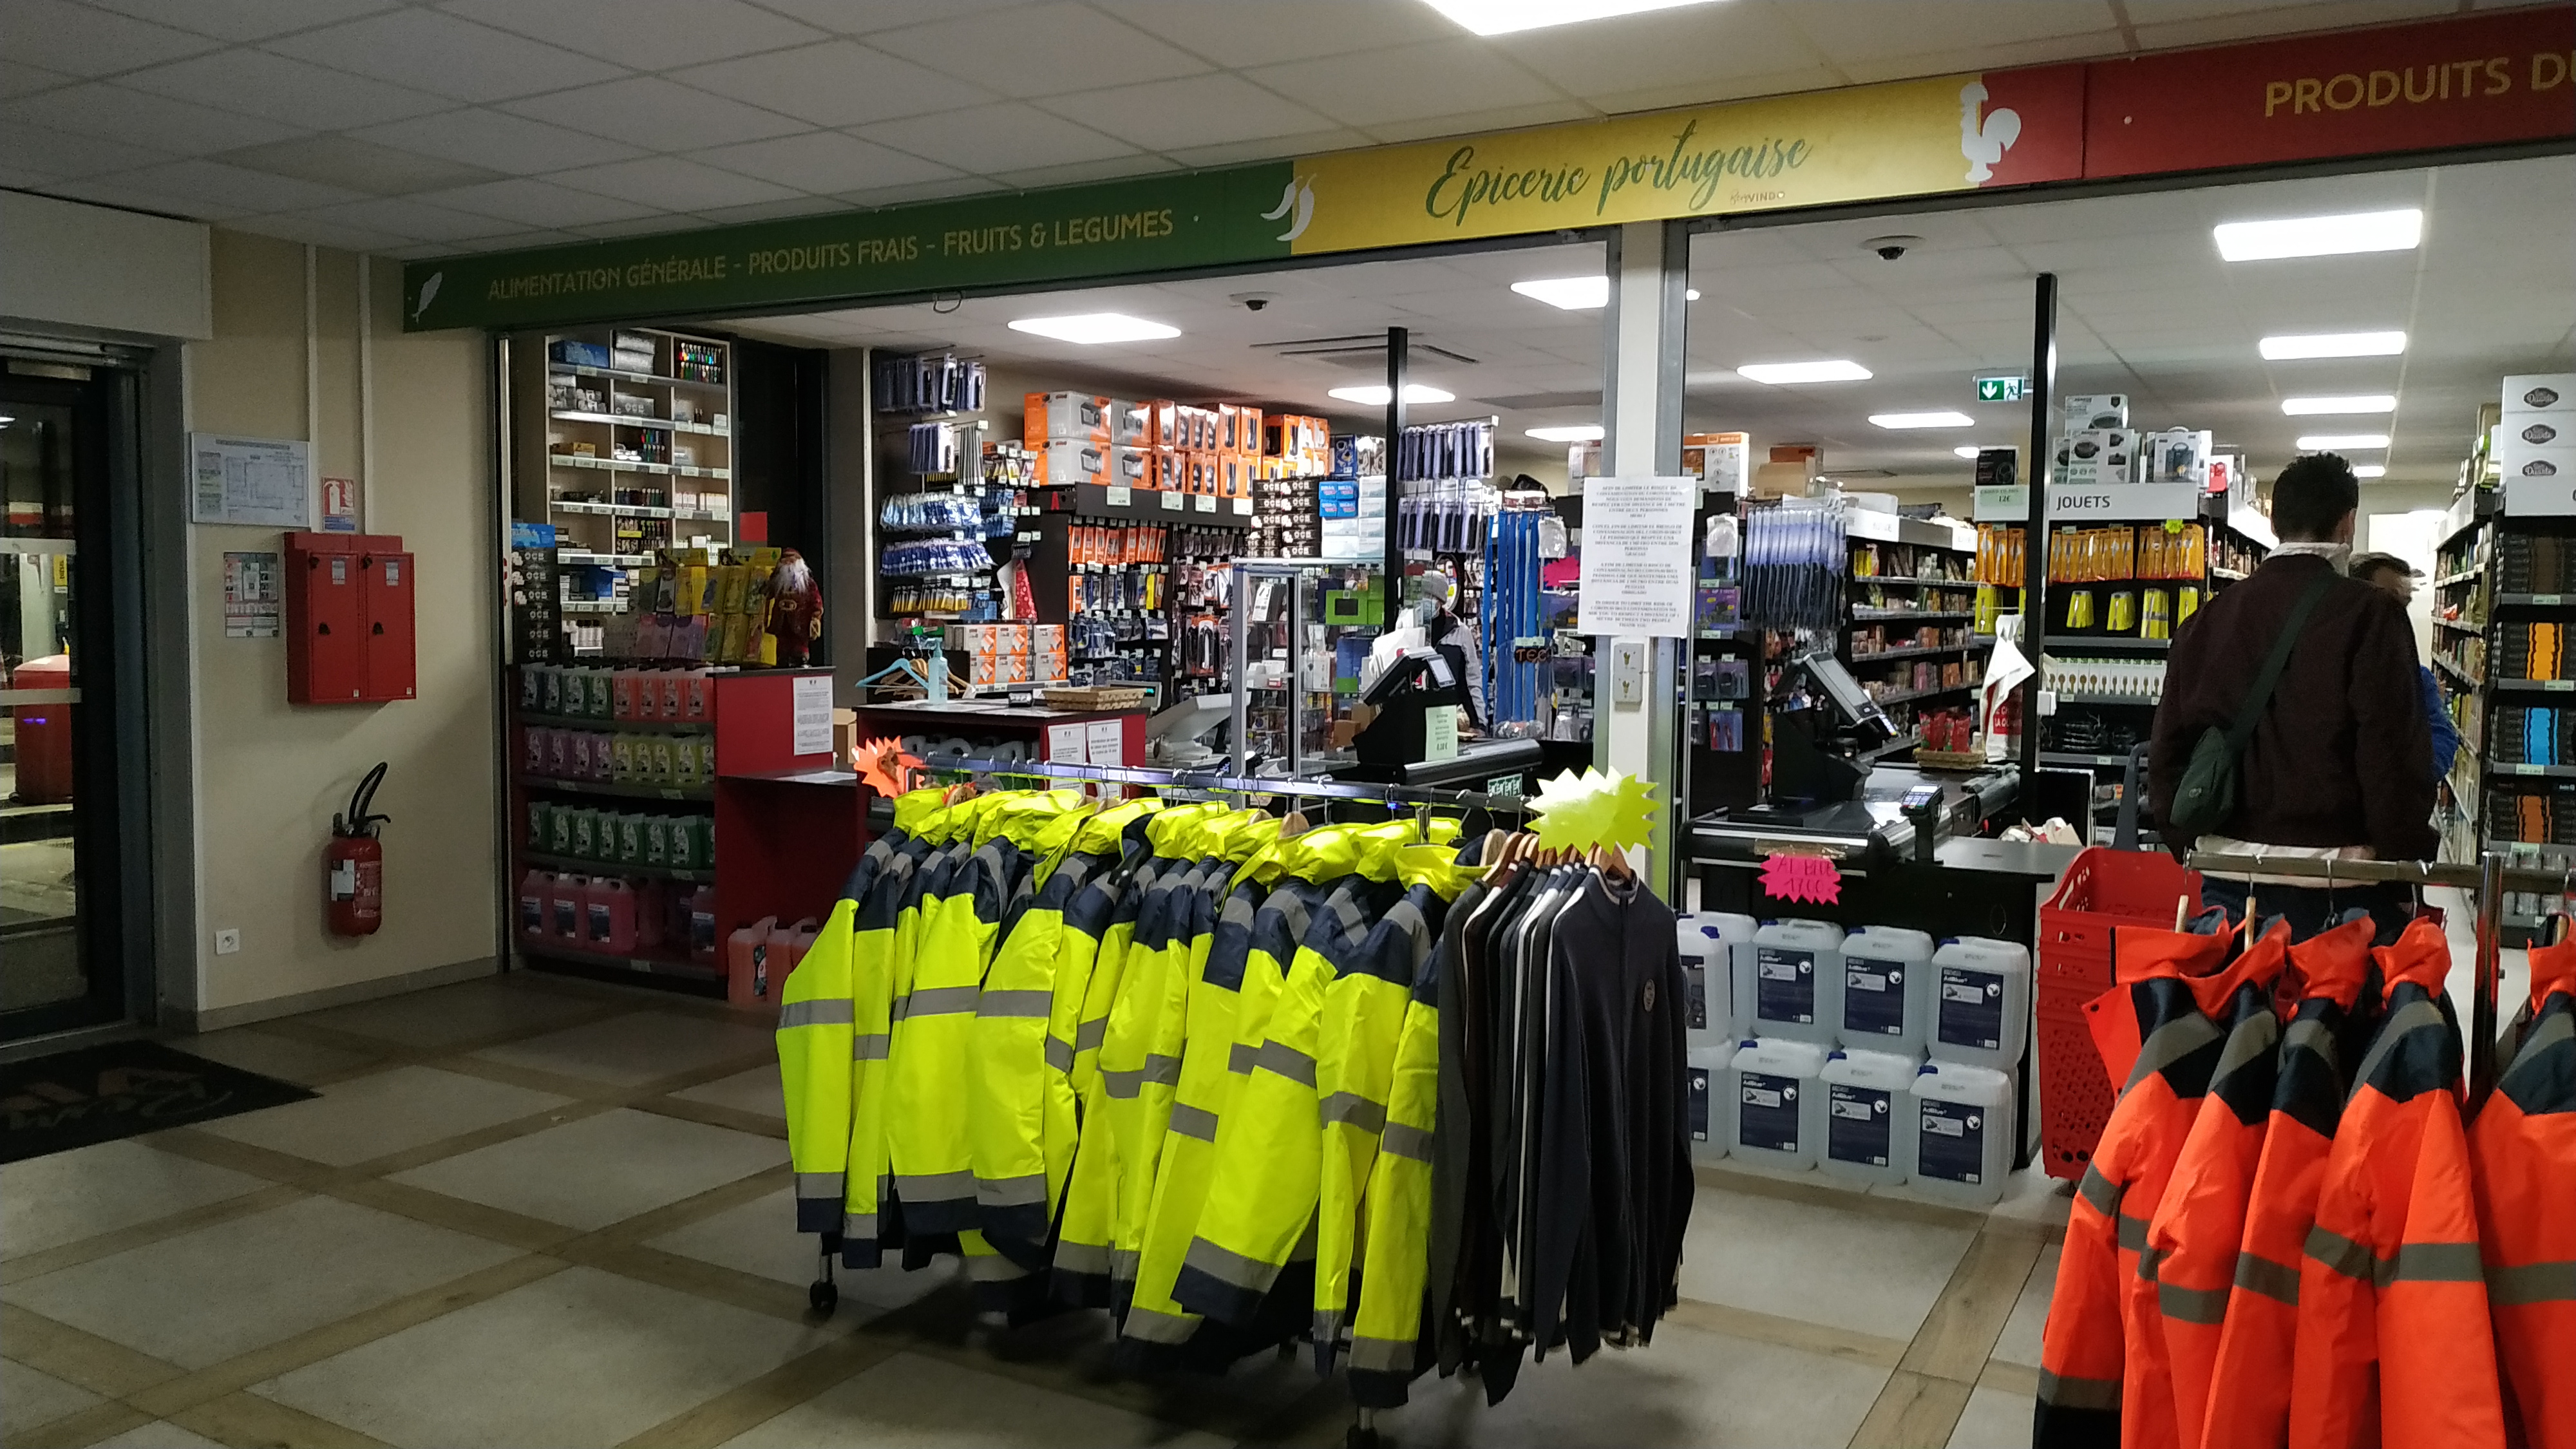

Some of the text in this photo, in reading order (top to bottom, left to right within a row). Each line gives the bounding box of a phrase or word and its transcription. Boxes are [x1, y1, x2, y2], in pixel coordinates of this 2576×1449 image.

[2264, 50, 2576, 117] PRODUITS D
[1596, 118, 1813, 216] portugaise
[488, 266, 621, 300] ALIMENTATION
[627, 255, 726, 287] GÉNÉRALE
[748, 243, 851, 275] PRODUITS
[858, 236, 918, 265] FRAIS
[943, 224, 1023, 256] FRUITS
[1030, 222, 1046, 248] &
[1054, 209, 1174, 247] LEGUMES
[2056, 495, 2110, 511] JOUETS
